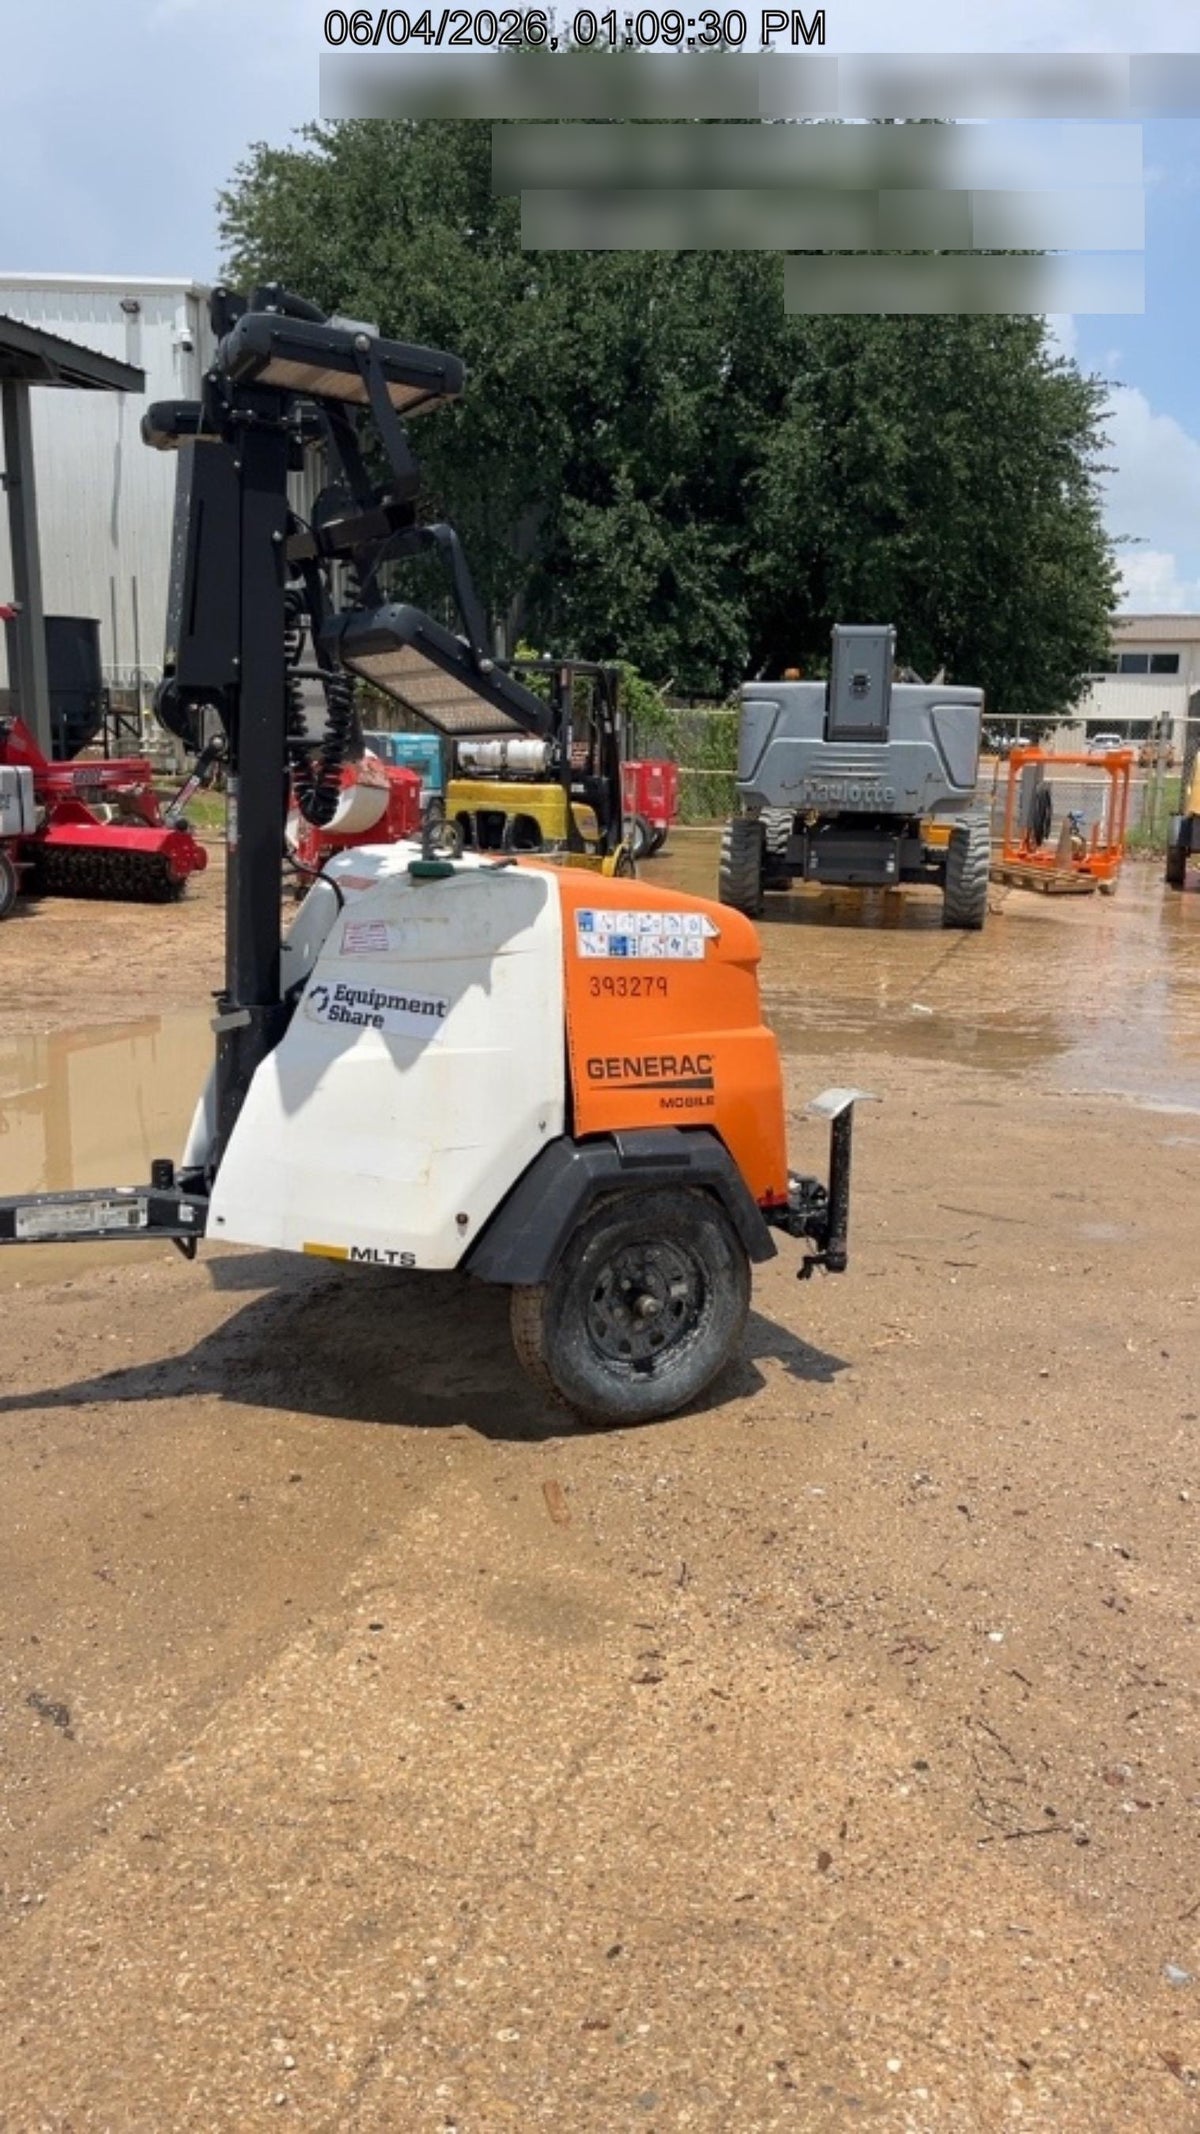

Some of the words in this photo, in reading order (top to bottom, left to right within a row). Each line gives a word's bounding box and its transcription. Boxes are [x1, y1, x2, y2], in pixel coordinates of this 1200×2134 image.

[589, 976, 669, 998] 393279
[333, 983, 447, 1018] Equipment
[327, 1004, 385, 1029] Share
[587, 1054, 714, 1080] GENERAC
[659, 1095, 715, 1108] MOBILE
[350, 1246, 416, 1267] MLTS
